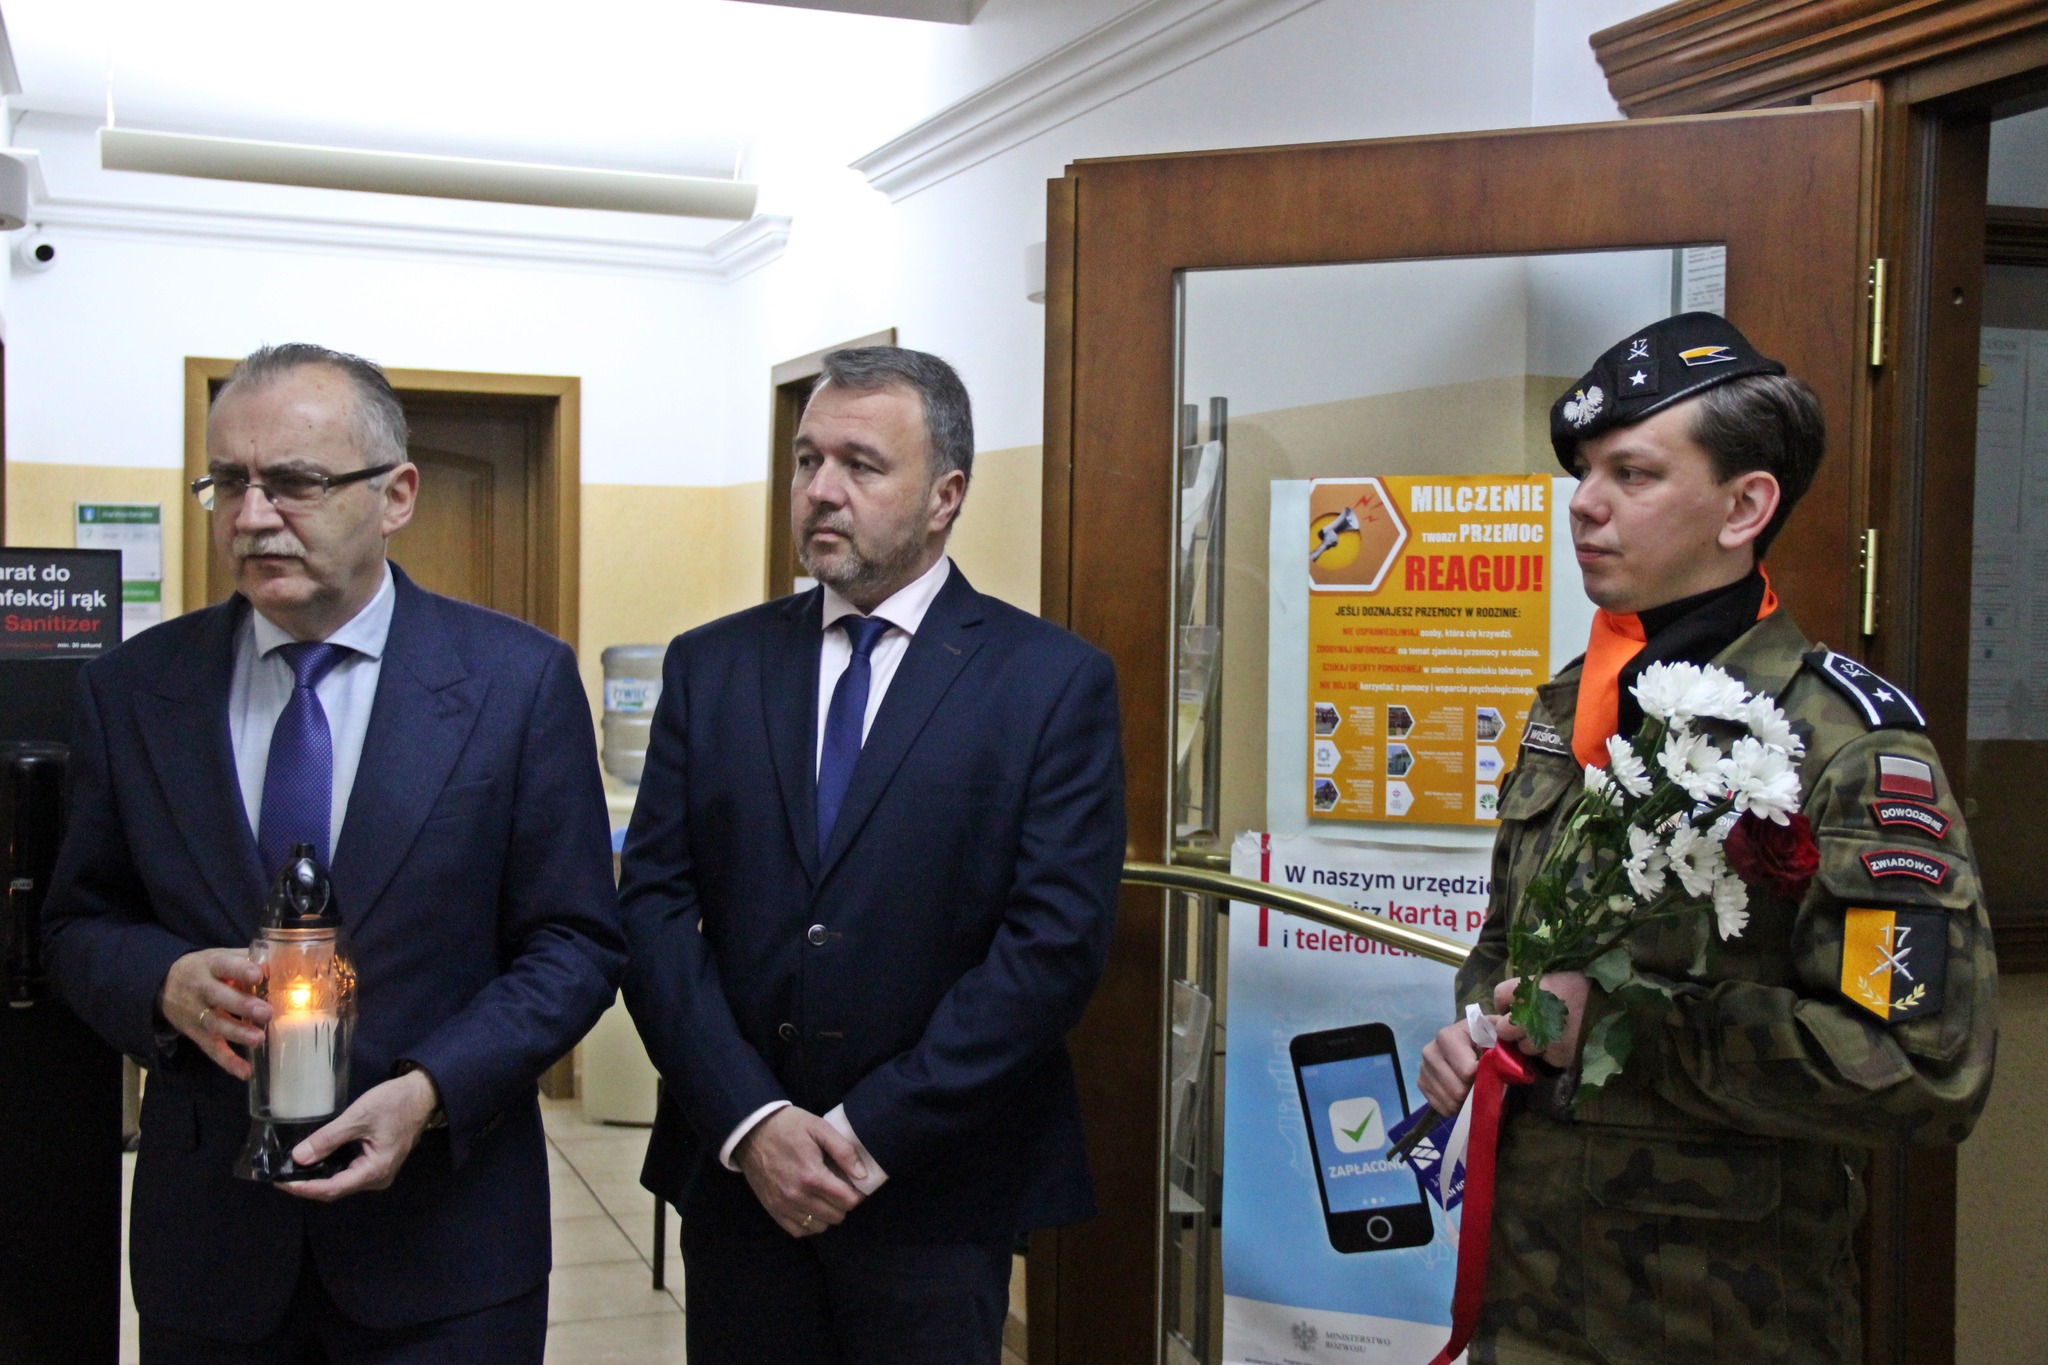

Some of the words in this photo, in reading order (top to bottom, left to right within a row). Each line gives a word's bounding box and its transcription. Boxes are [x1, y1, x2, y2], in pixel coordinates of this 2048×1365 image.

[1632, 339, 1647, 349] 17
[1411, 484, 1544, 512] MILCZENIE
[1421, 532, 1457, 543] TWORZY
[1459, 523, 1543, 543] PRZEMOC
[42, 564, 70, 582] do
[1404, 554, 1543, 592] REAGUJ!
[71, 590, 107, 612] rąk
[1335, 605, 1359, 616] JEŚLI
[1362, 606, 1413, 617] DOZNAJESZ
[1415, 607, 1462, 618] PRZEMOCY
[1465, 608, 1475, 618] W
[1476, 608, 1521, 618] RODZINIE:
[5, 614, 101, 632] Sanitizer
[1285, 865, 1305, 883] W
[1313, 868, 1395, 891] naszym
[1870, 858, 1939, 878] ZWIADOWCA
[1389, 900, 1458, 931] kartą
[1283, 930, 1288, 948] i
[1880, 925, 1911, 948] 17
[1325, 1331, 1391, 1346] MINISTERSTWO
[1325, 1341, 1366, 1353] ROZWOJU
